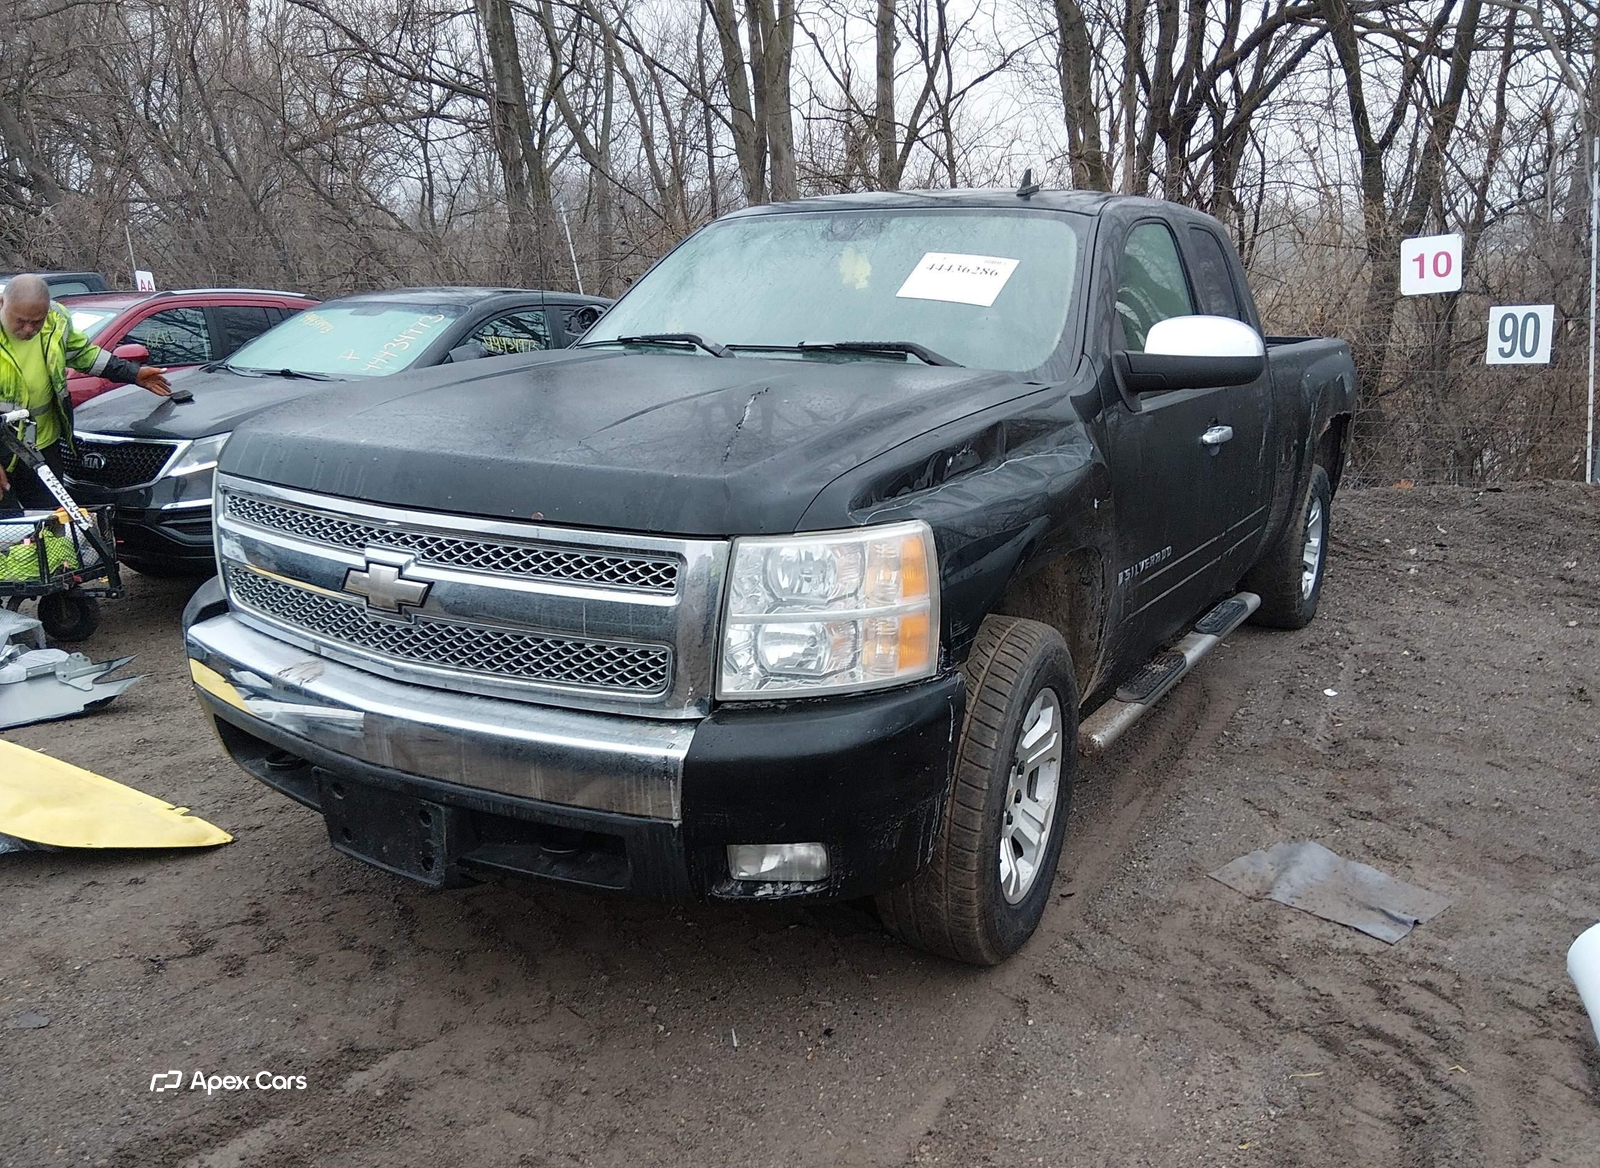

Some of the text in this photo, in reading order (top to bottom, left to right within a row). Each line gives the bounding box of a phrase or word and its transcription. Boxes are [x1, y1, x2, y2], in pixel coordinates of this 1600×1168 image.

[926, 263, 998, 277] 44436286
[1412, 251, 1452, 279] 10
[140, 278, 154, 292] AA
[1498, 312, 1540, 358] 90
[1123, 545, 1172, 581] SILVERADO
